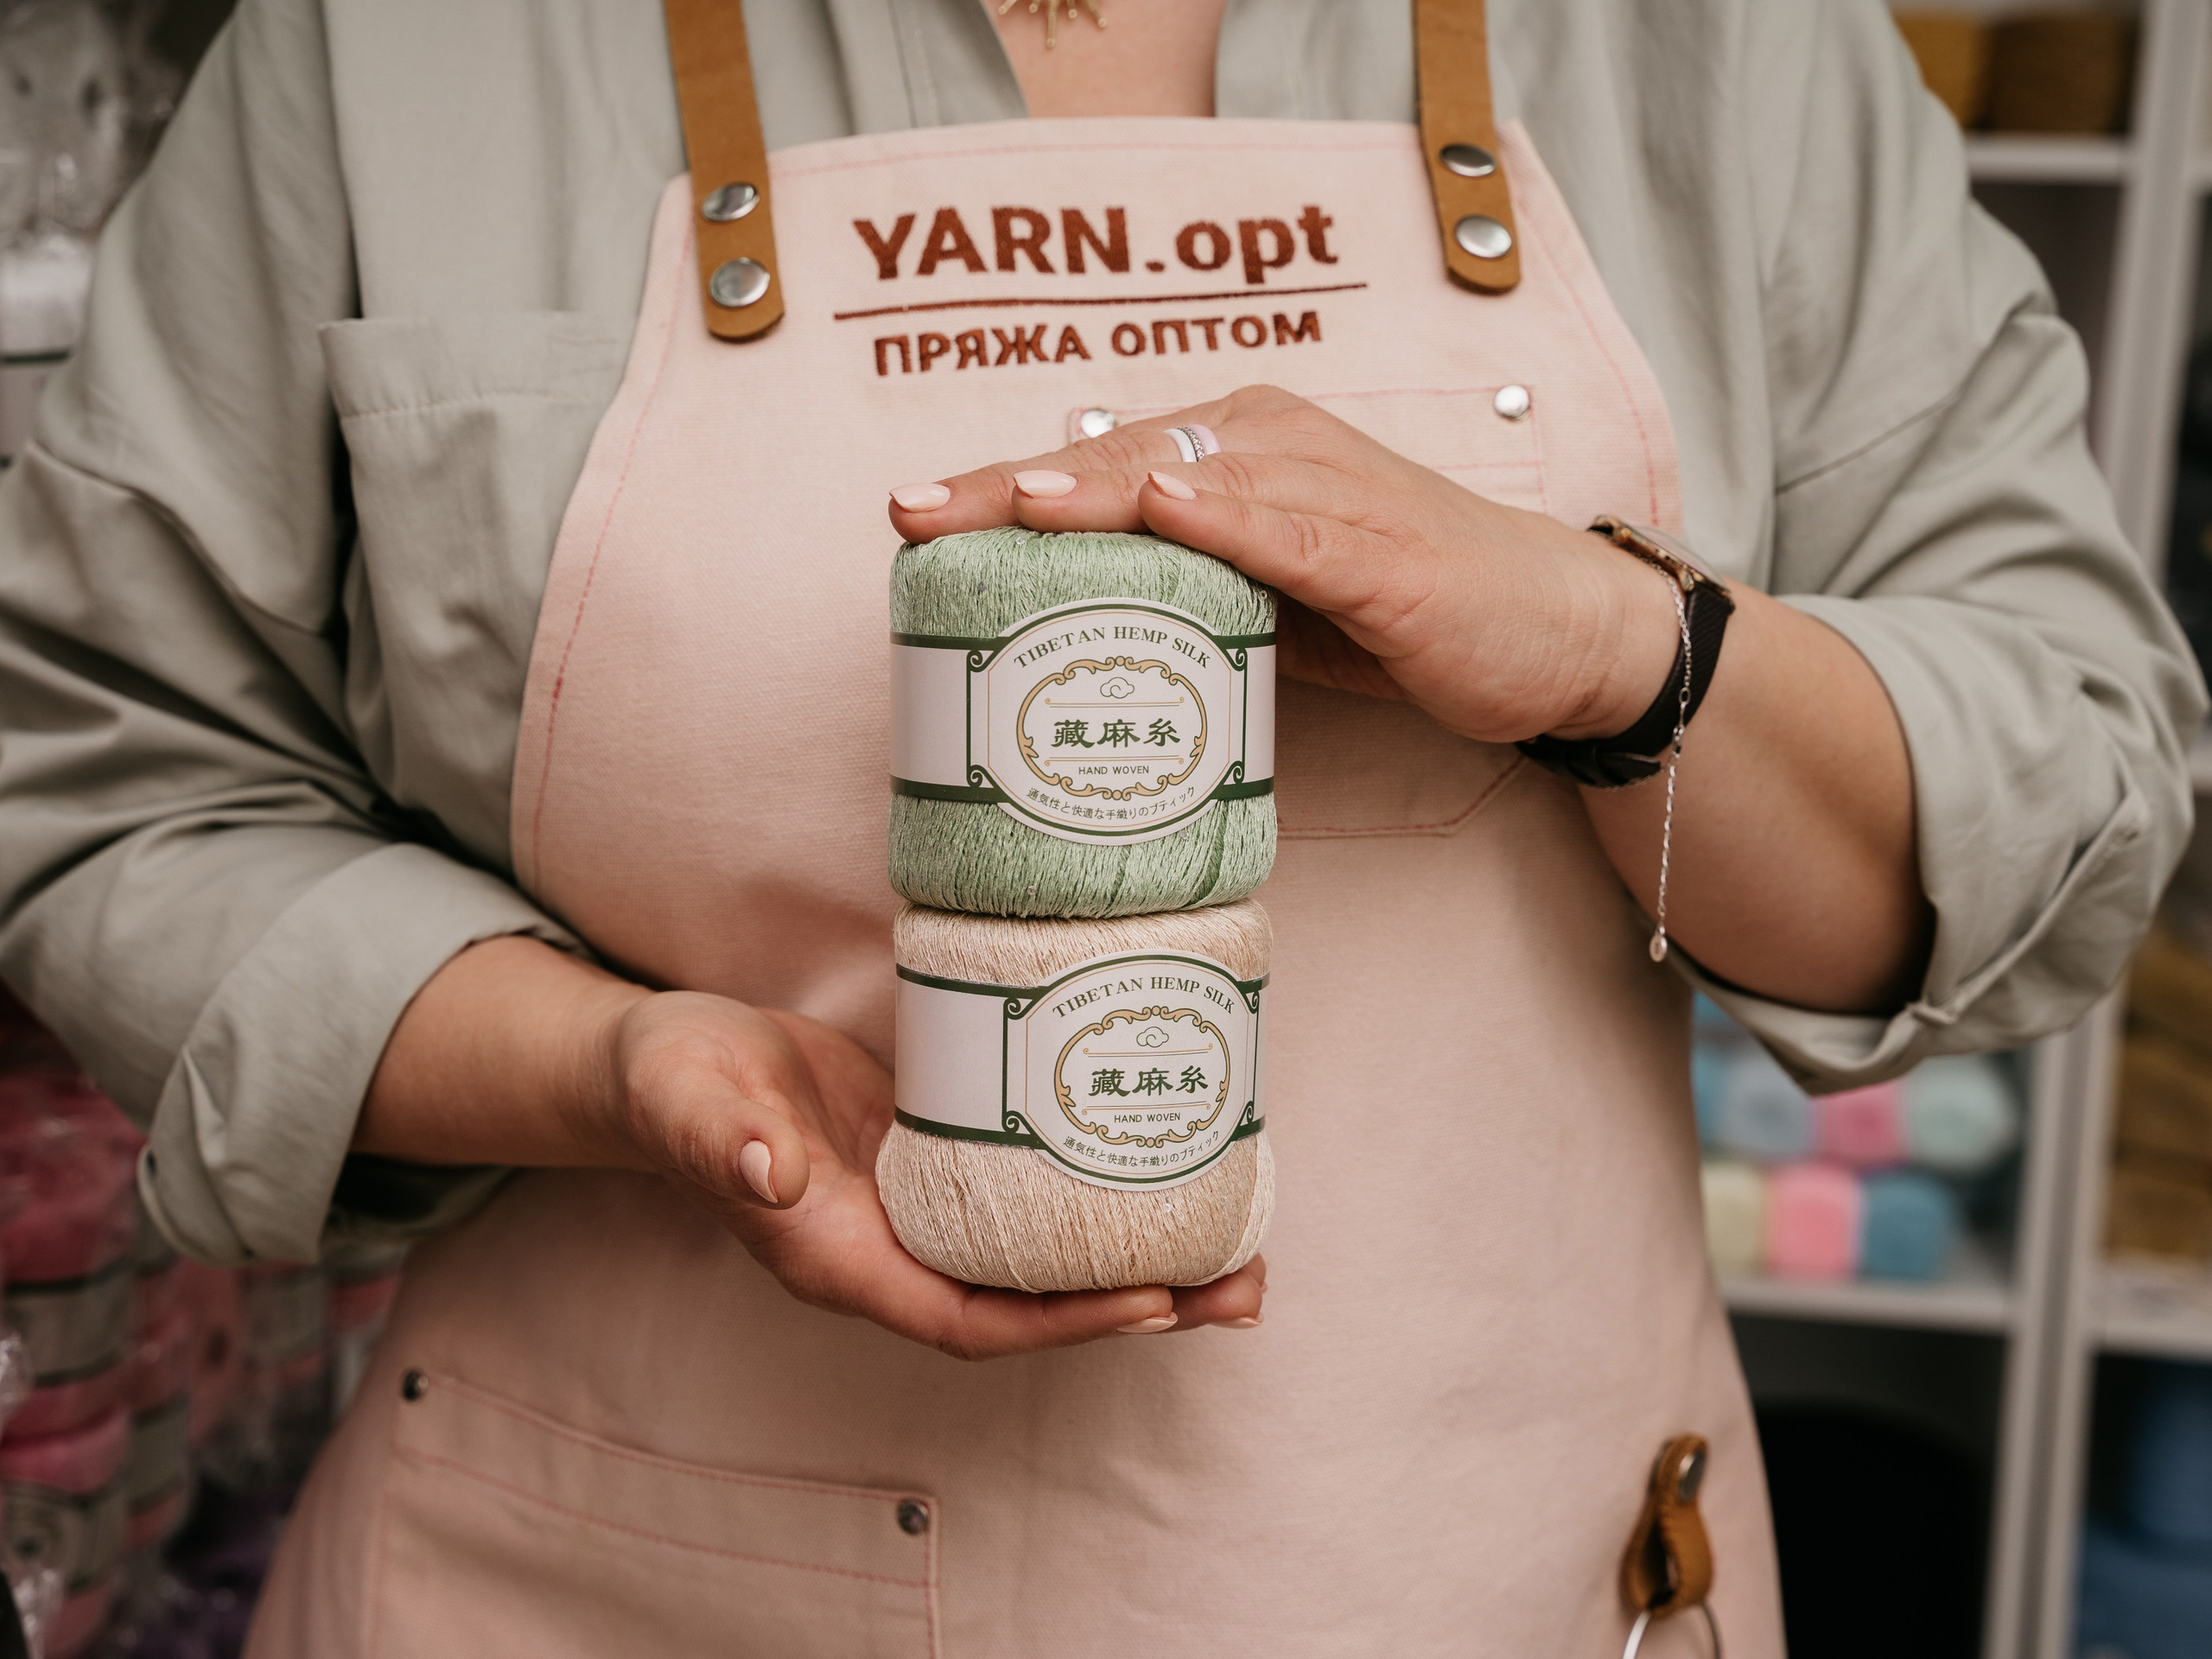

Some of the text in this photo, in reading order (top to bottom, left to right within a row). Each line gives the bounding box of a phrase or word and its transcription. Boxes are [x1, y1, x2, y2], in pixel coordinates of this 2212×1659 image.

[852, 205, 1338, 284] YARN.opt
[874, 311, 1323, 376] ПРЯЖА ОПТОМ
[1014, 626, 1211, 669] TIBETAN HEMP SILK
[1078, 766, 1149, 775] HAND WOVEN
[1052, 976, 1235, 1019] TIBETAN HEMP SILK
[1114, 1113, 1180, 1122] HAND WOVEN
